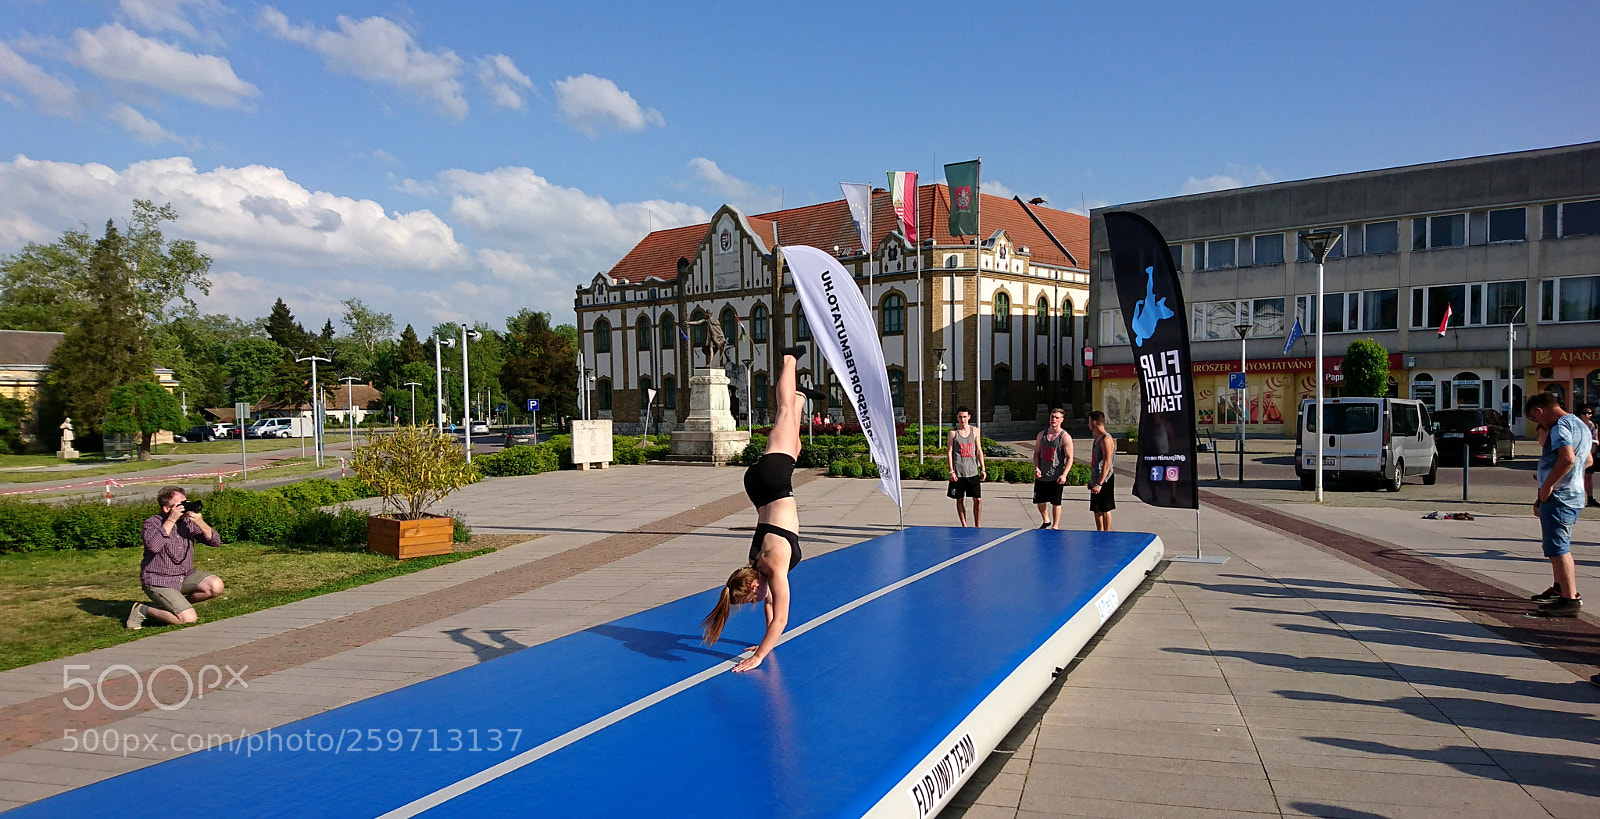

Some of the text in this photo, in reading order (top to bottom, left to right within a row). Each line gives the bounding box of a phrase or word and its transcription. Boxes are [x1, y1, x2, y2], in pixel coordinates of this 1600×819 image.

[1231, 374, 1237, 382] P
[529, 400, 538, 410] P
[912, 733, 977, 819] FLIP UNIT TEAM
